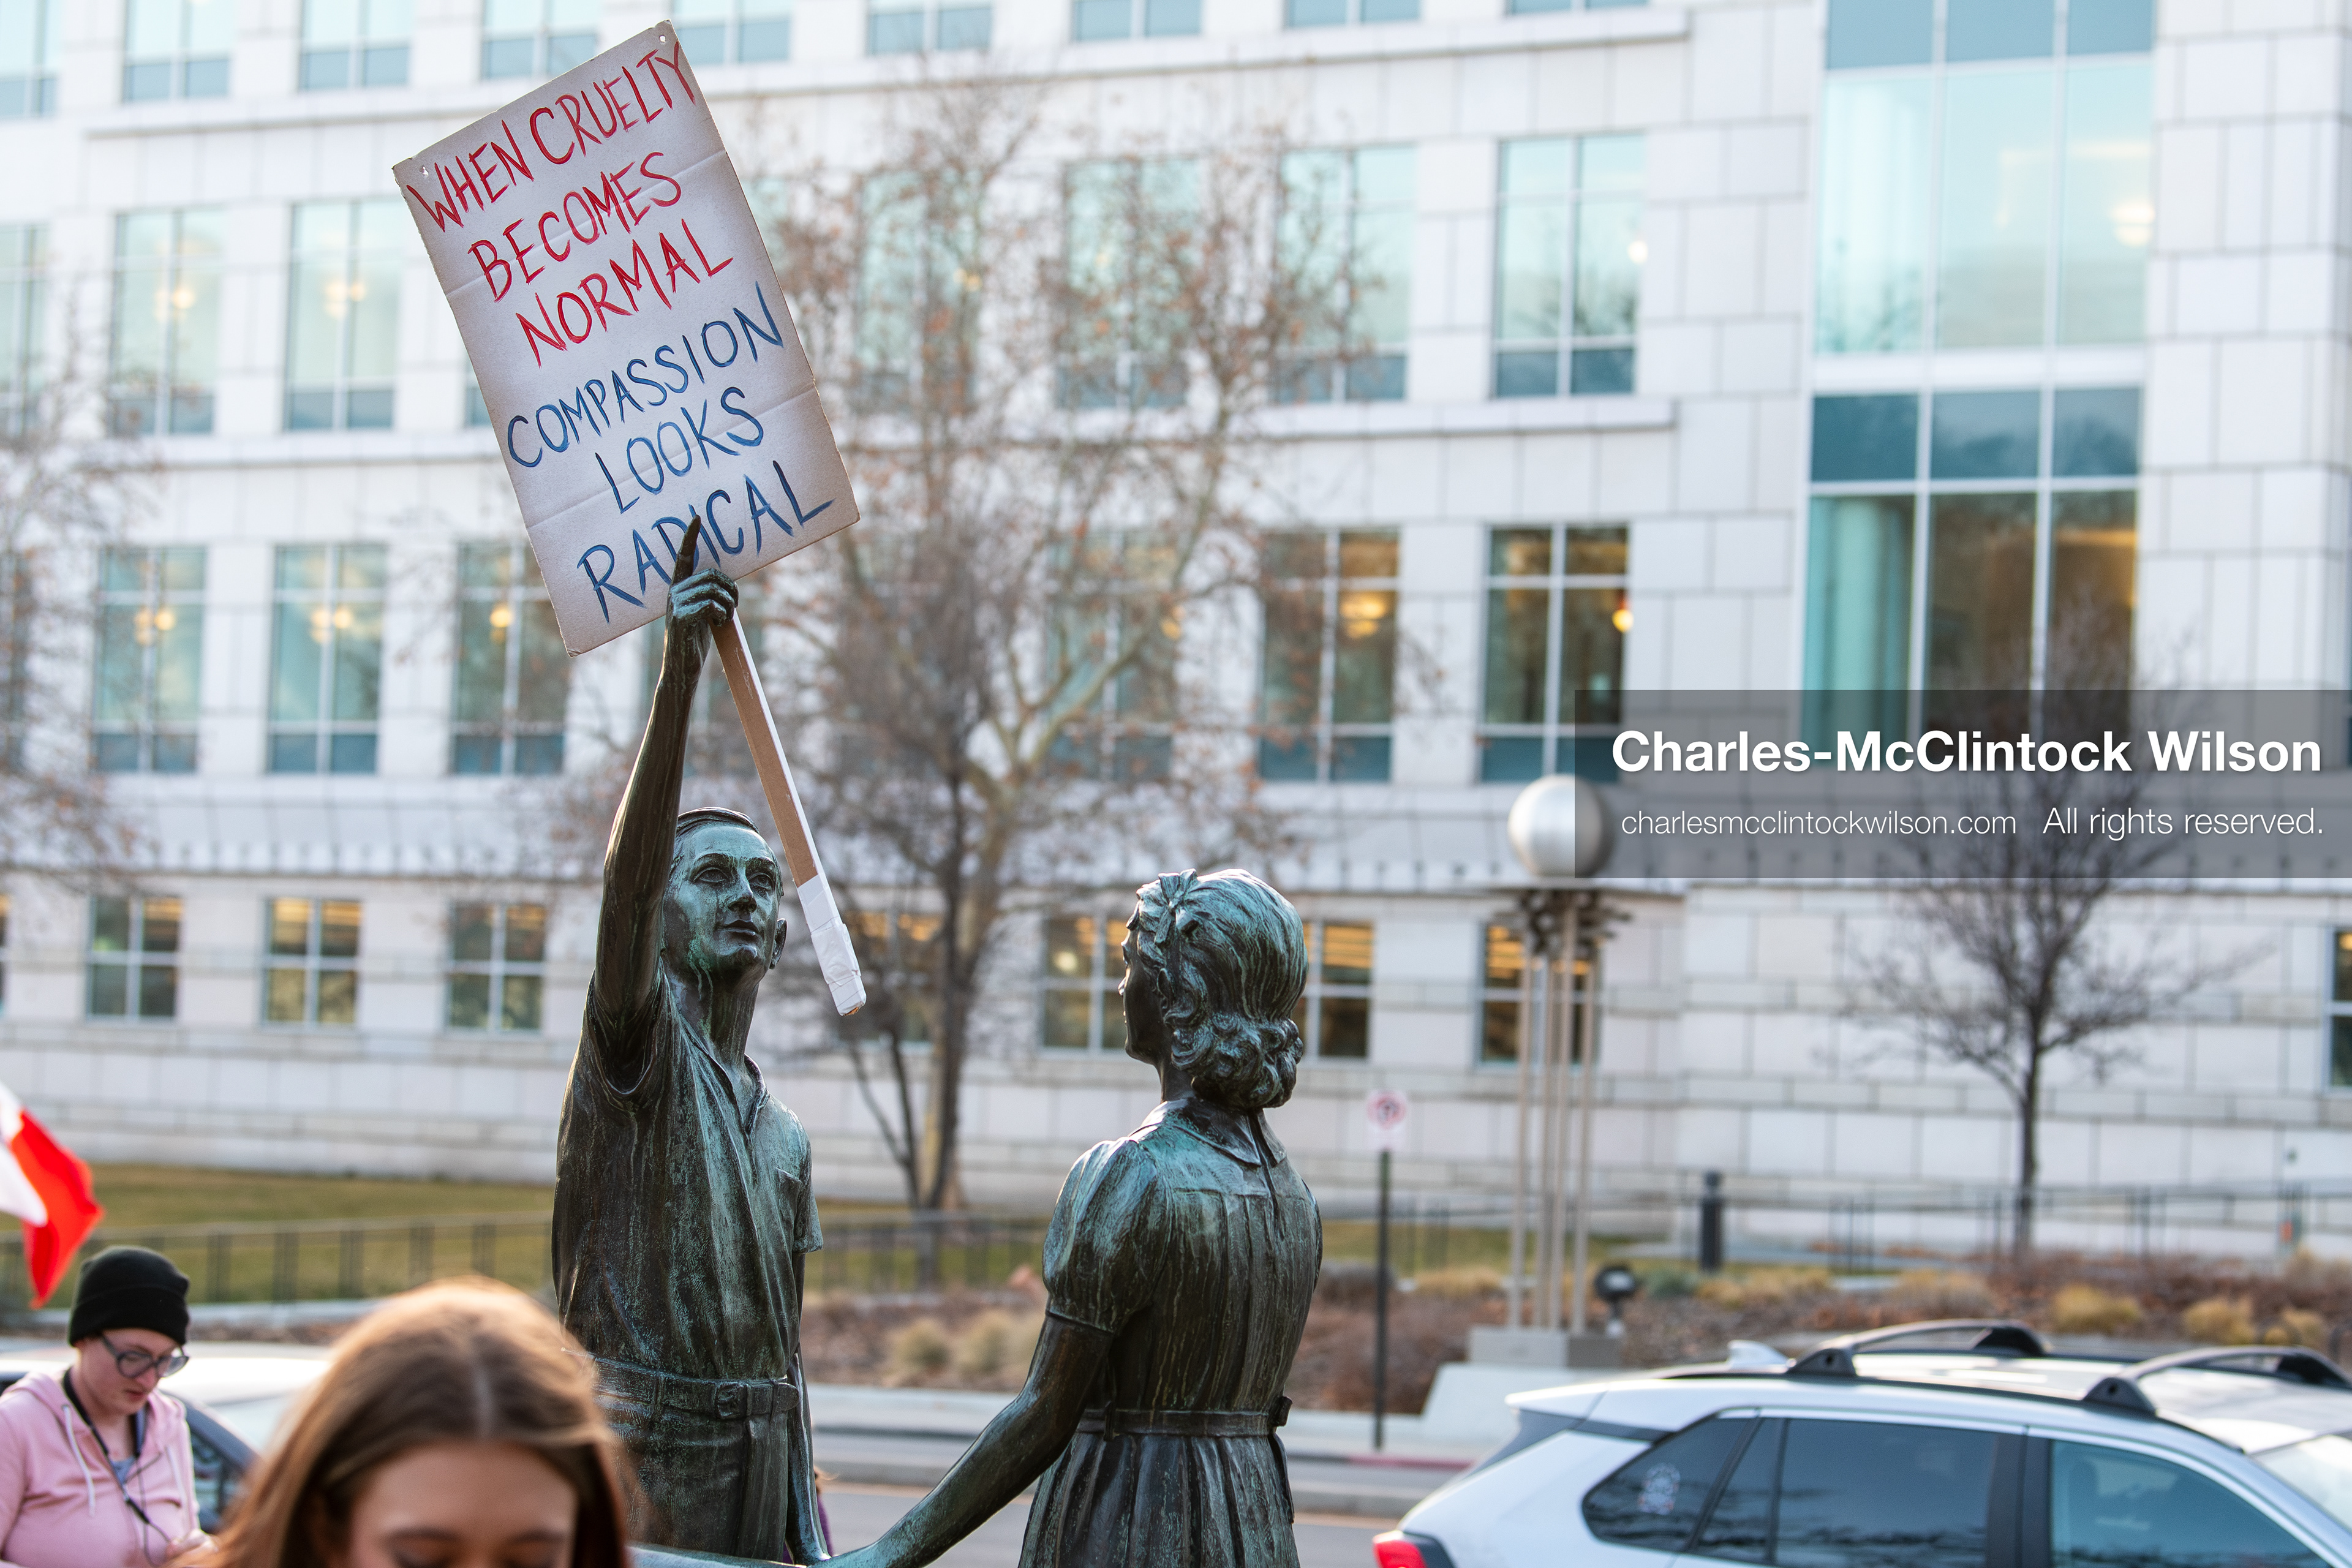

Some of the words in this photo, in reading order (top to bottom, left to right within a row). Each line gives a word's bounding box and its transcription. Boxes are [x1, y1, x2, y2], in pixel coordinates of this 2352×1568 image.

[407, 119, 534, 233] WHEN
[529, 40, 696, 165] CRUELTY
[467, 152, 682, 303] BECOMES
[515, 218, 734, 368] NORMAL
[507, 281, 784, 469] COMPASSION
[595, 386, 765, 514] LOOKS
